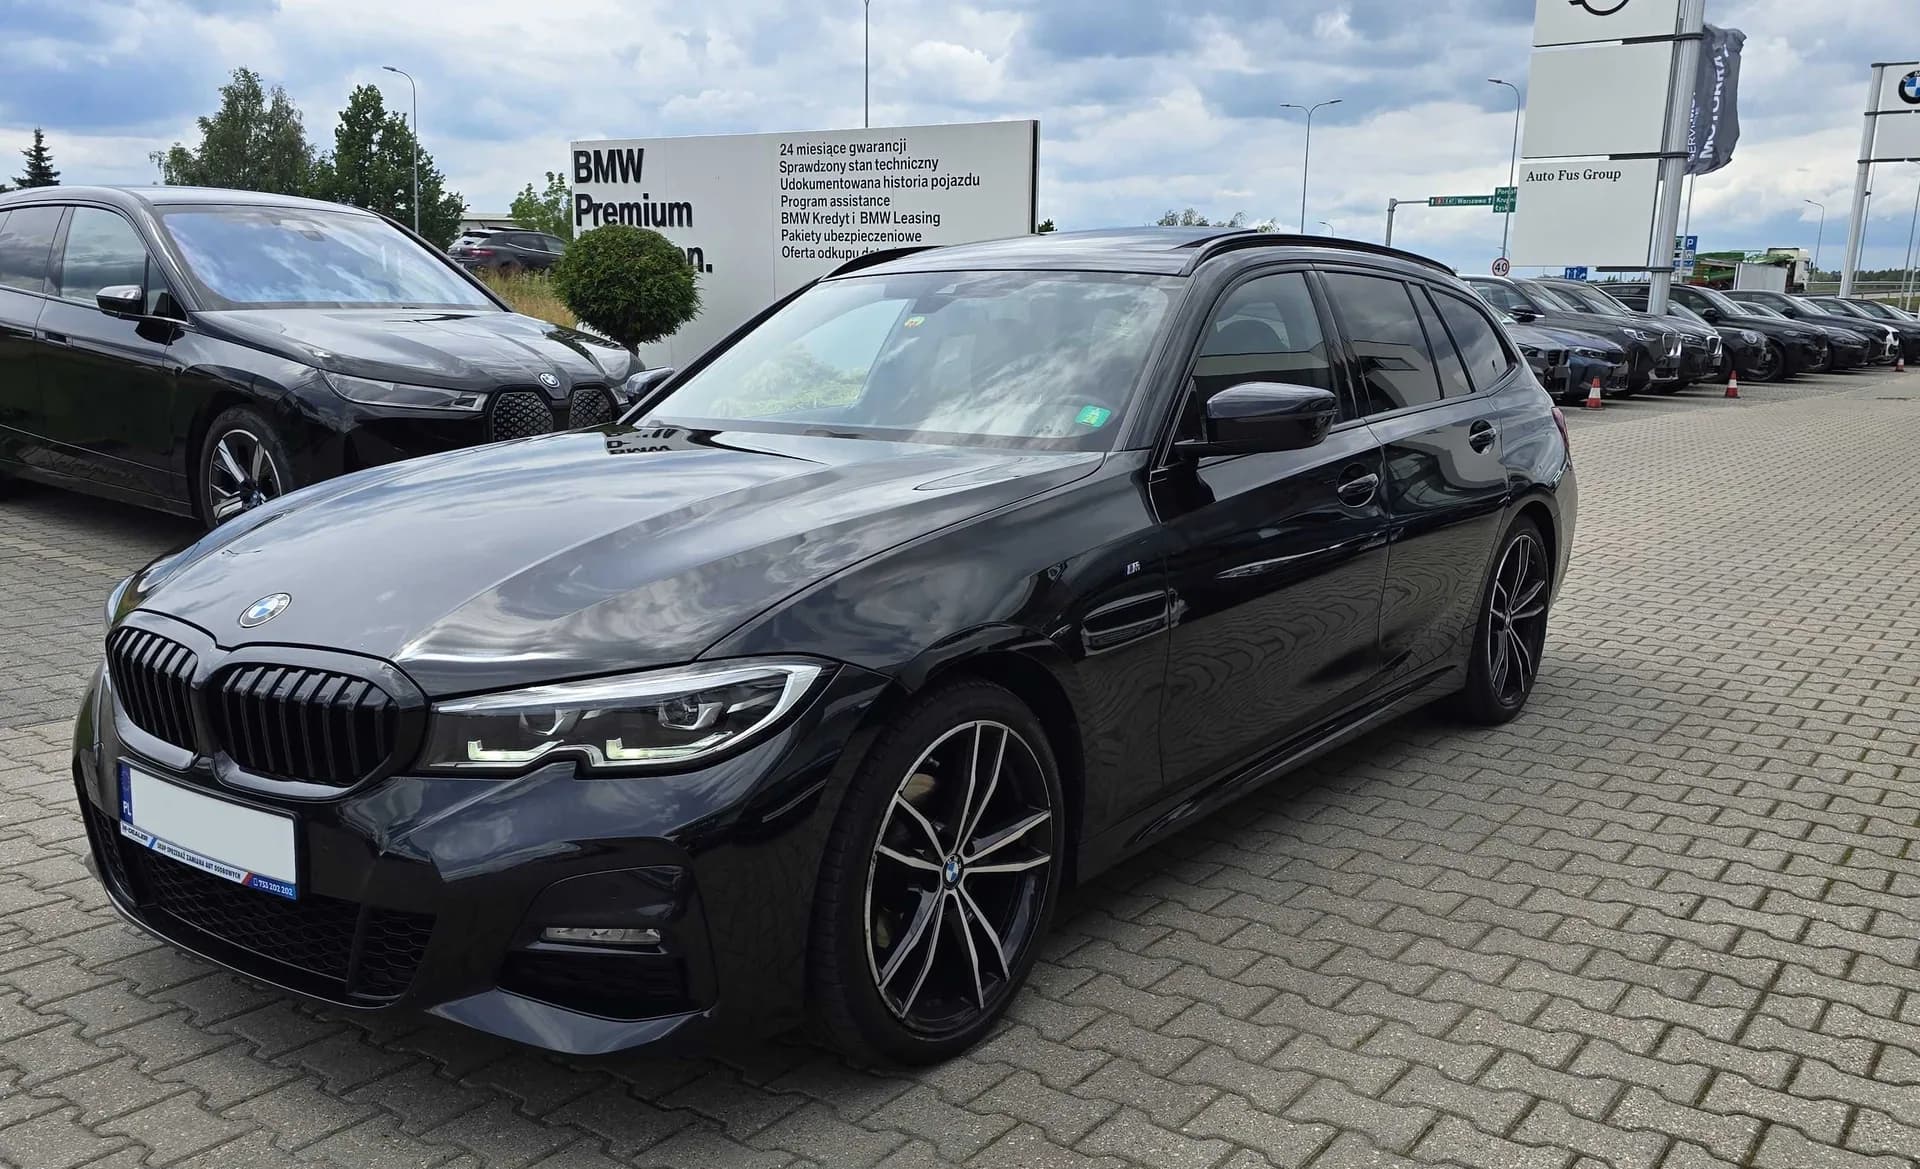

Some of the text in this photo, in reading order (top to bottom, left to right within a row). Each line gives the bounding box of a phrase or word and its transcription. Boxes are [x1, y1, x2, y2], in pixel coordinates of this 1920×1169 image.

[780, 138, 907, 158] 24 miesiące gwarancji
[573, 148, 645, 184] BMW
[779, 156, 939, 175] Sprawdzony stan techniczny
[780, 172, 981, 191] Udokumentowana historia pojazdu
[1526, 169, 1622, 182] Auto Fus Group
[780, 194, 891, 210] Program assistance
[575, 193, 693, 228] Premium
[781, 210, 941, 227] BMW Kredyt i BMW Leasing
[781, 229, 922, 244] Pakiety ubezpieczeniowe
[782, 245, 816, 259] Oferta
[817, 246, 859, 261] odkupu
[1494, 262, 1508, 273] 40
[123, 801, 132, 816] PL
[281, 886, 293, 896] 202
